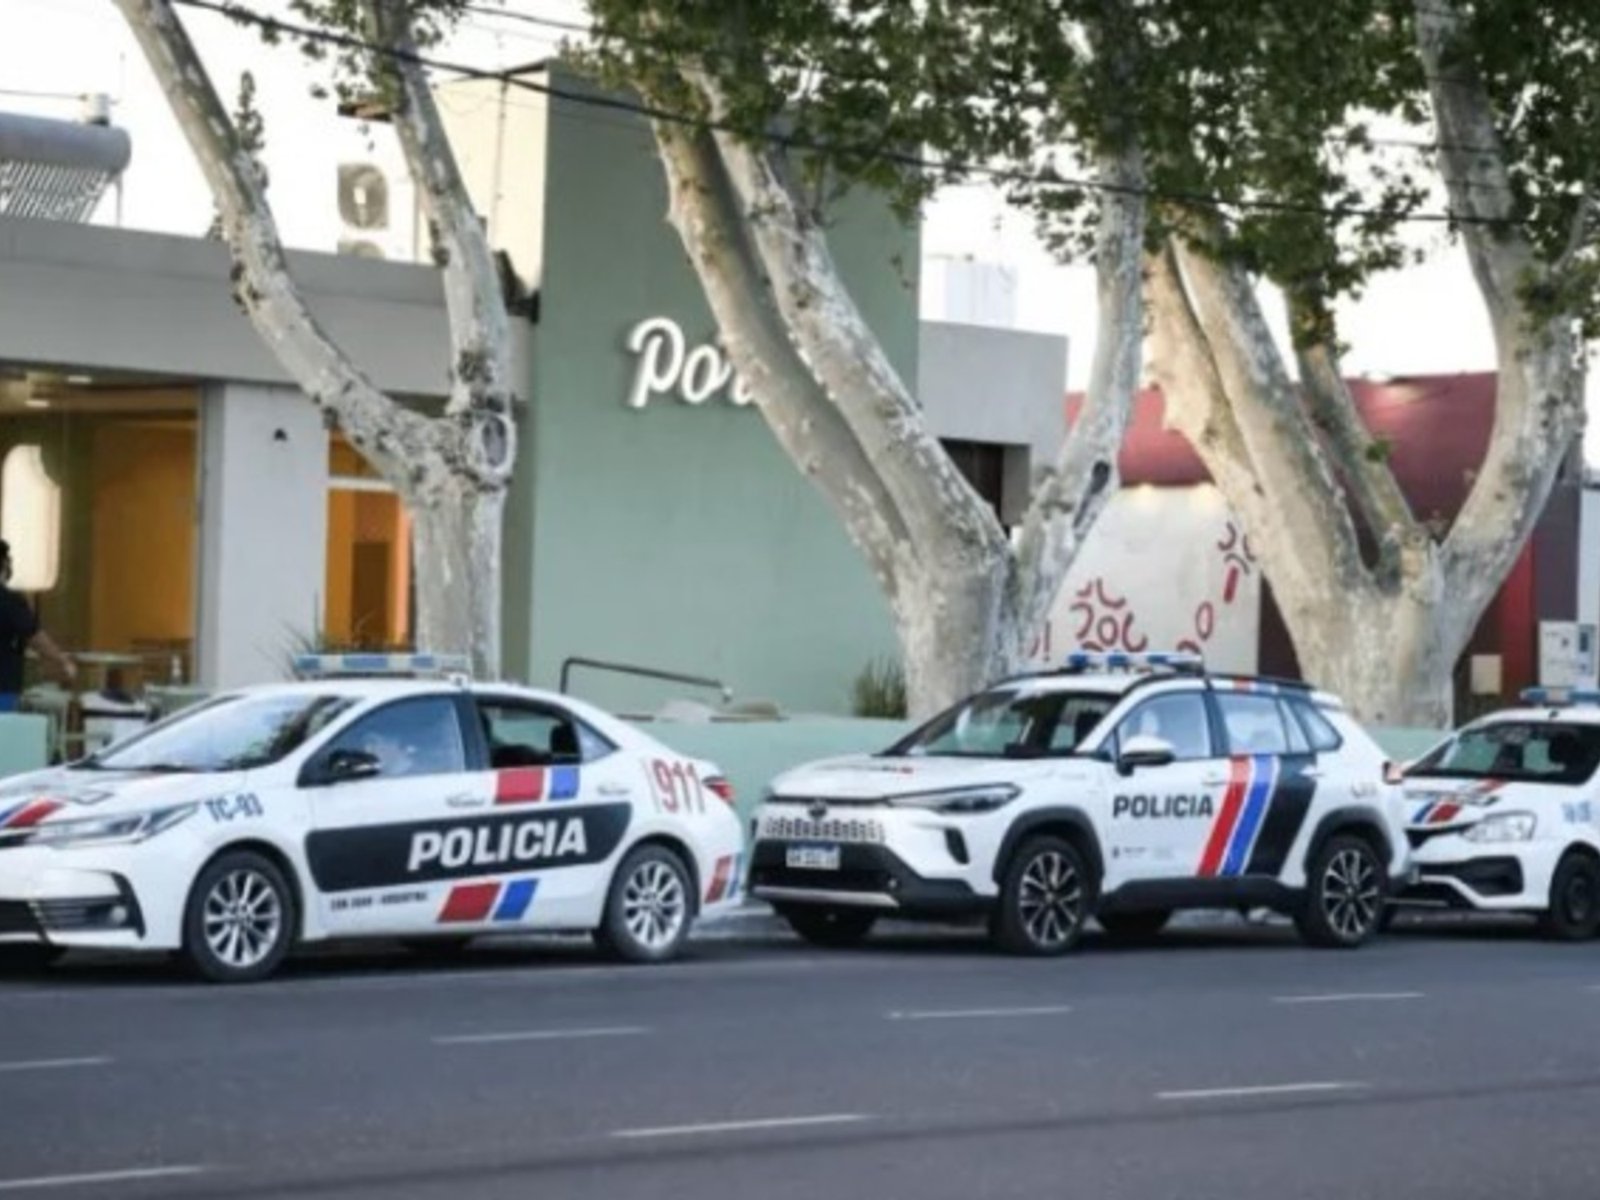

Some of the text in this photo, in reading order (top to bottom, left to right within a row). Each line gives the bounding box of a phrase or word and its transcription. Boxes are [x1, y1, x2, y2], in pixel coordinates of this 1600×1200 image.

[629, 316, 752, 408] Po
[652, 758, 706, 814] 911
[1112, 794, 1213, 819] POLICIA
[407, 817, 588, 872] POLICIA
